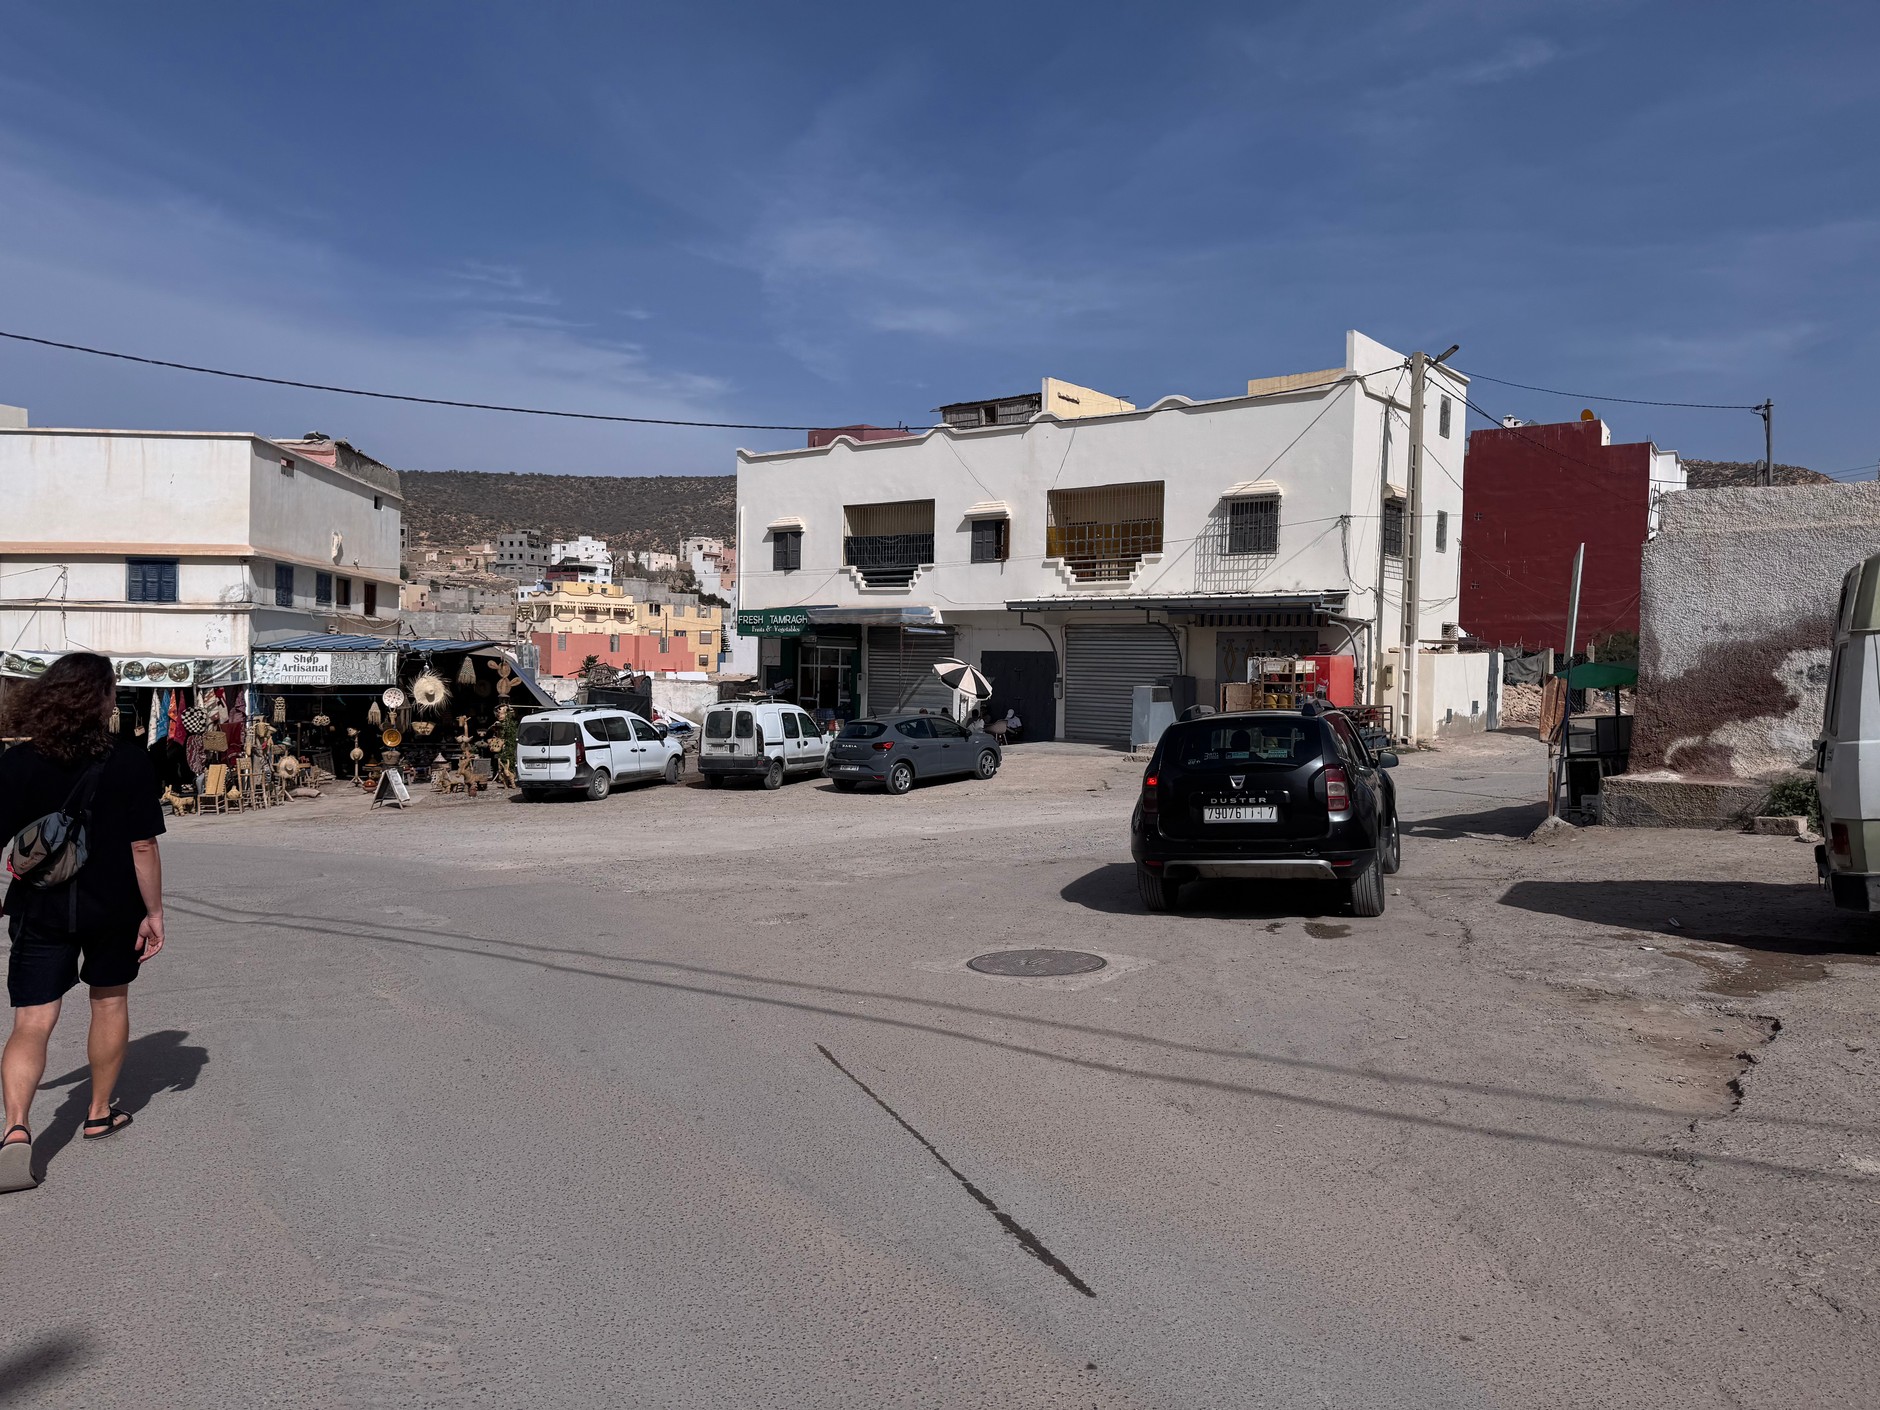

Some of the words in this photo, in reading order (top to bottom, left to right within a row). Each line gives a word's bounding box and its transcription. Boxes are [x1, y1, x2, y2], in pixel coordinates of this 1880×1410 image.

[738, 615, 763, 624] FRESH
[774, 625, 800, 633] Vegetables
[293, 654, 319, 664] Shop
[281, 664, 328, 672] Artisanat
[1208, 807, 1241, 819] 79076
